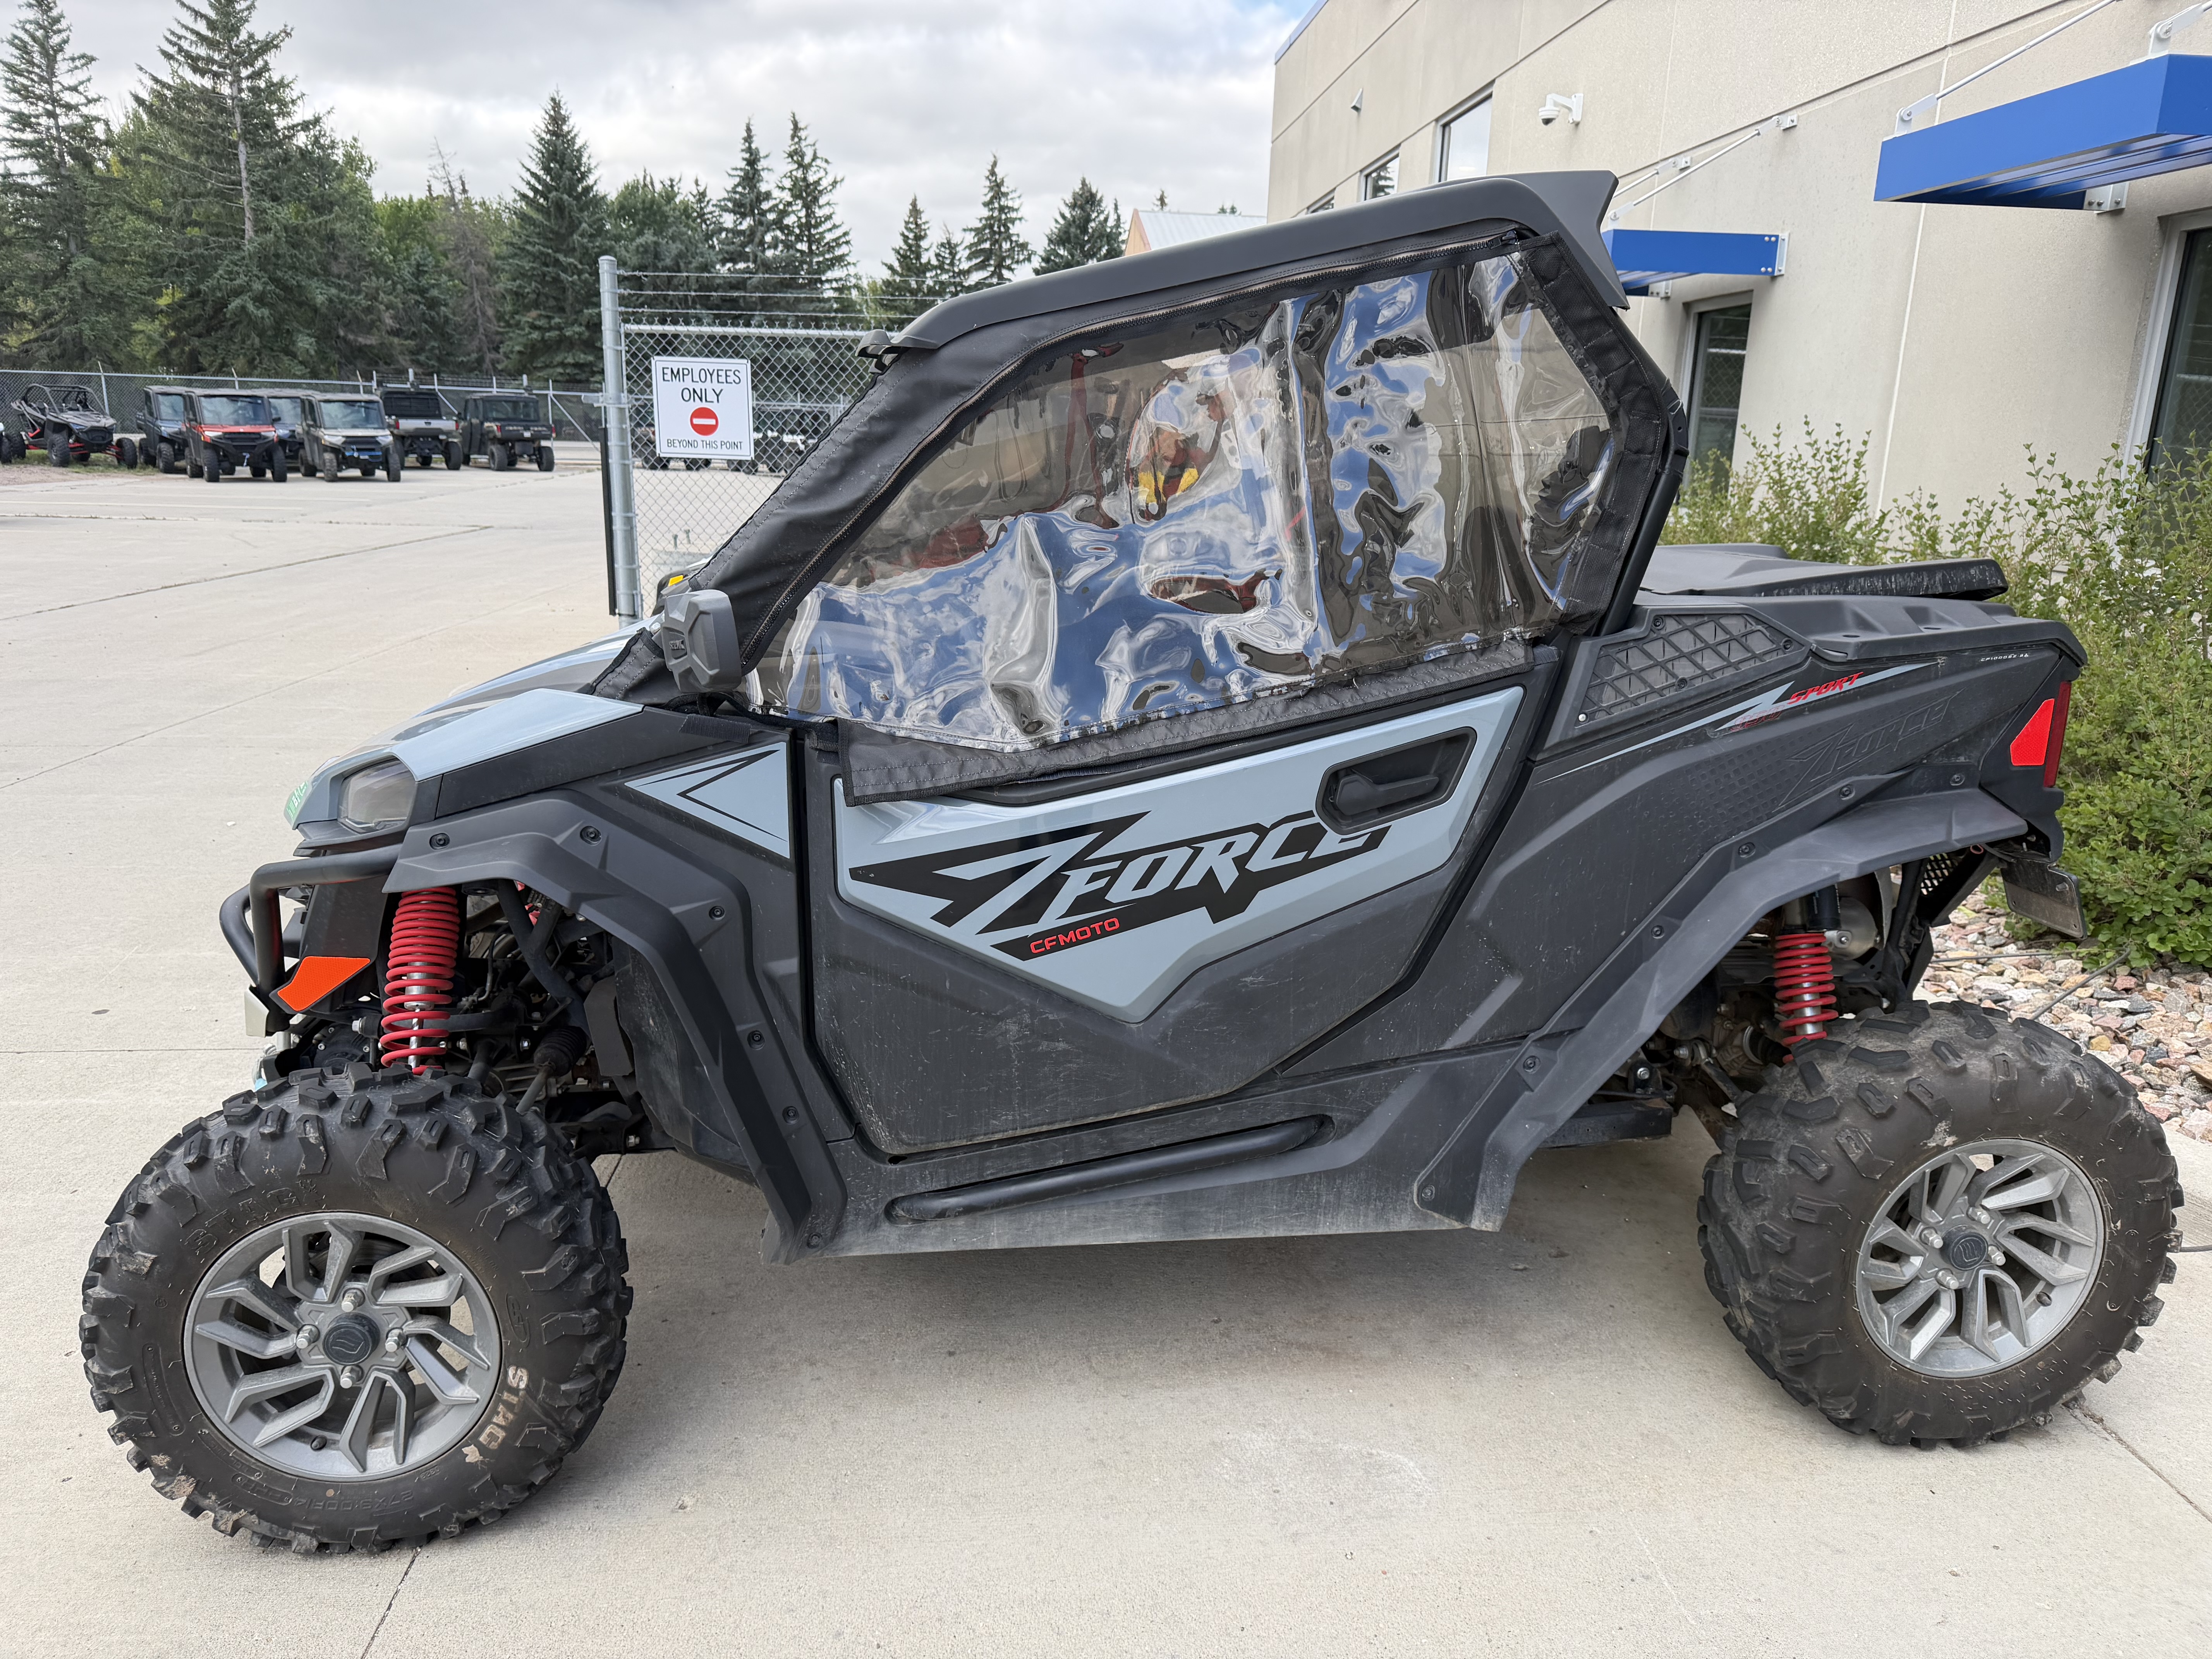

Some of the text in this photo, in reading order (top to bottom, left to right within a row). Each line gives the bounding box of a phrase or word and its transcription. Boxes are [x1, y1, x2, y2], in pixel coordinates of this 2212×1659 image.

[662, 367, 741, 385] EMPLOYEES
[681, 387, 723, 404] ONLY
[667, 439, 743, 450] BEYOND THIS POINT
[1787, 672, 1864, 705] SPORT
[1030, 917, 1120, 954] CFMOTO
[479, 1365, 529, 1450] STAG
